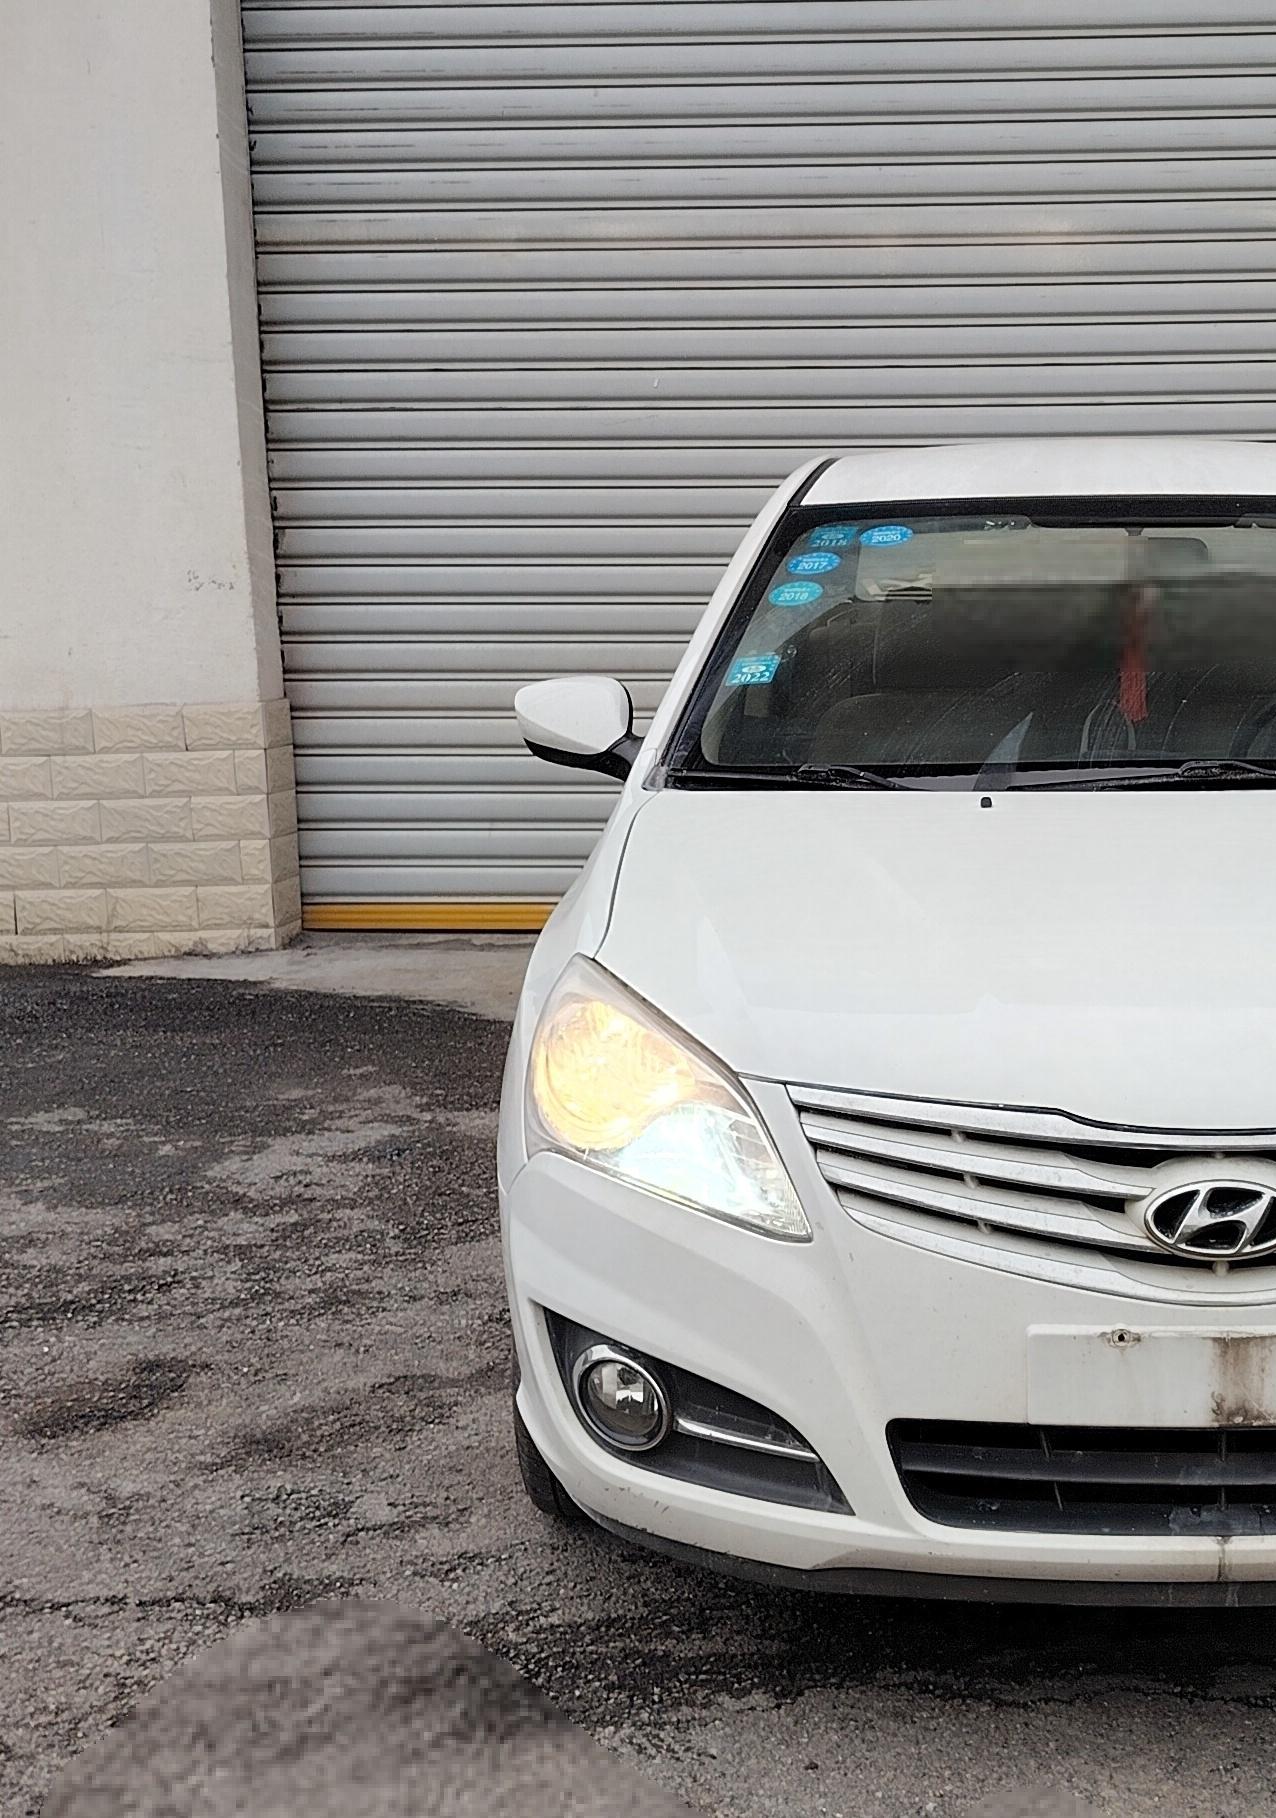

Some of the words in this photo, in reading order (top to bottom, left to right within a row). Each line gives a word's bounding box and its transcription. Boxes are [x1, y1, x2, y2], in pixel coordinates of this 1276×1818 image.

[872, 533, 902, 543] 2020
[797, 561, 829, 570] 2017
[731, 671, 770, 684] 2022
